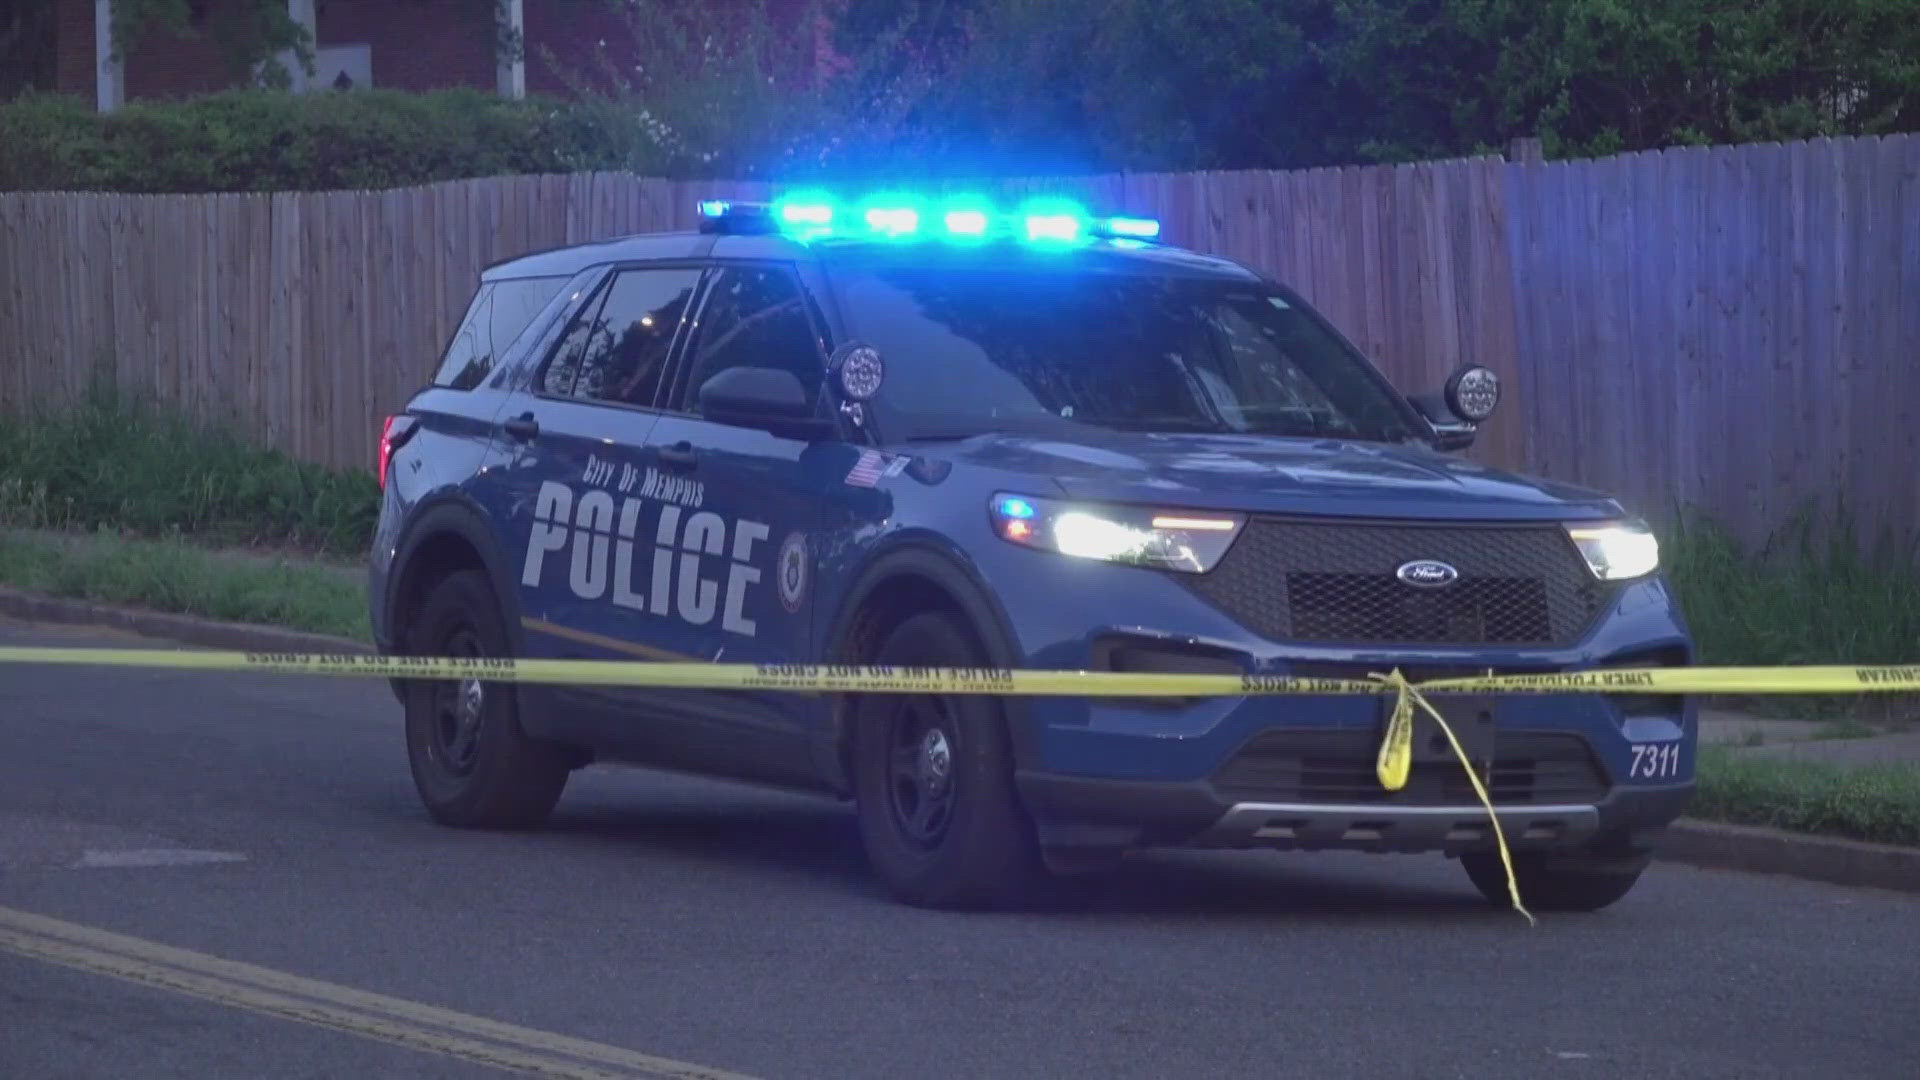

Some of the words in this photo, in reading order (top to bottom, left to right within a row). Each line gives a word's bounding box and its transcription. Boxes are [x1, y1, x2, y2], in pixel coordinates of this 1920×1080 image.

[583, 454, 615, 487] CITY
[618, 462, 639, 492] OF
[640, 467, 704, 507] MEMPHIS
[521, 480, 770, 637] POLICE
[246, 653, 310, 664] CROSS
[319, 655, 356, 664] NOT
[447, 658, 516, 669] POLICE
[757, 664, 818, 677] CROSS
[825, 665, 862, 677] NOT
[949, 668, 1013, 682] POLICE
[1240, 675, 1300, 692] CROSS
[1630, 744, 1679, 778] 7311
